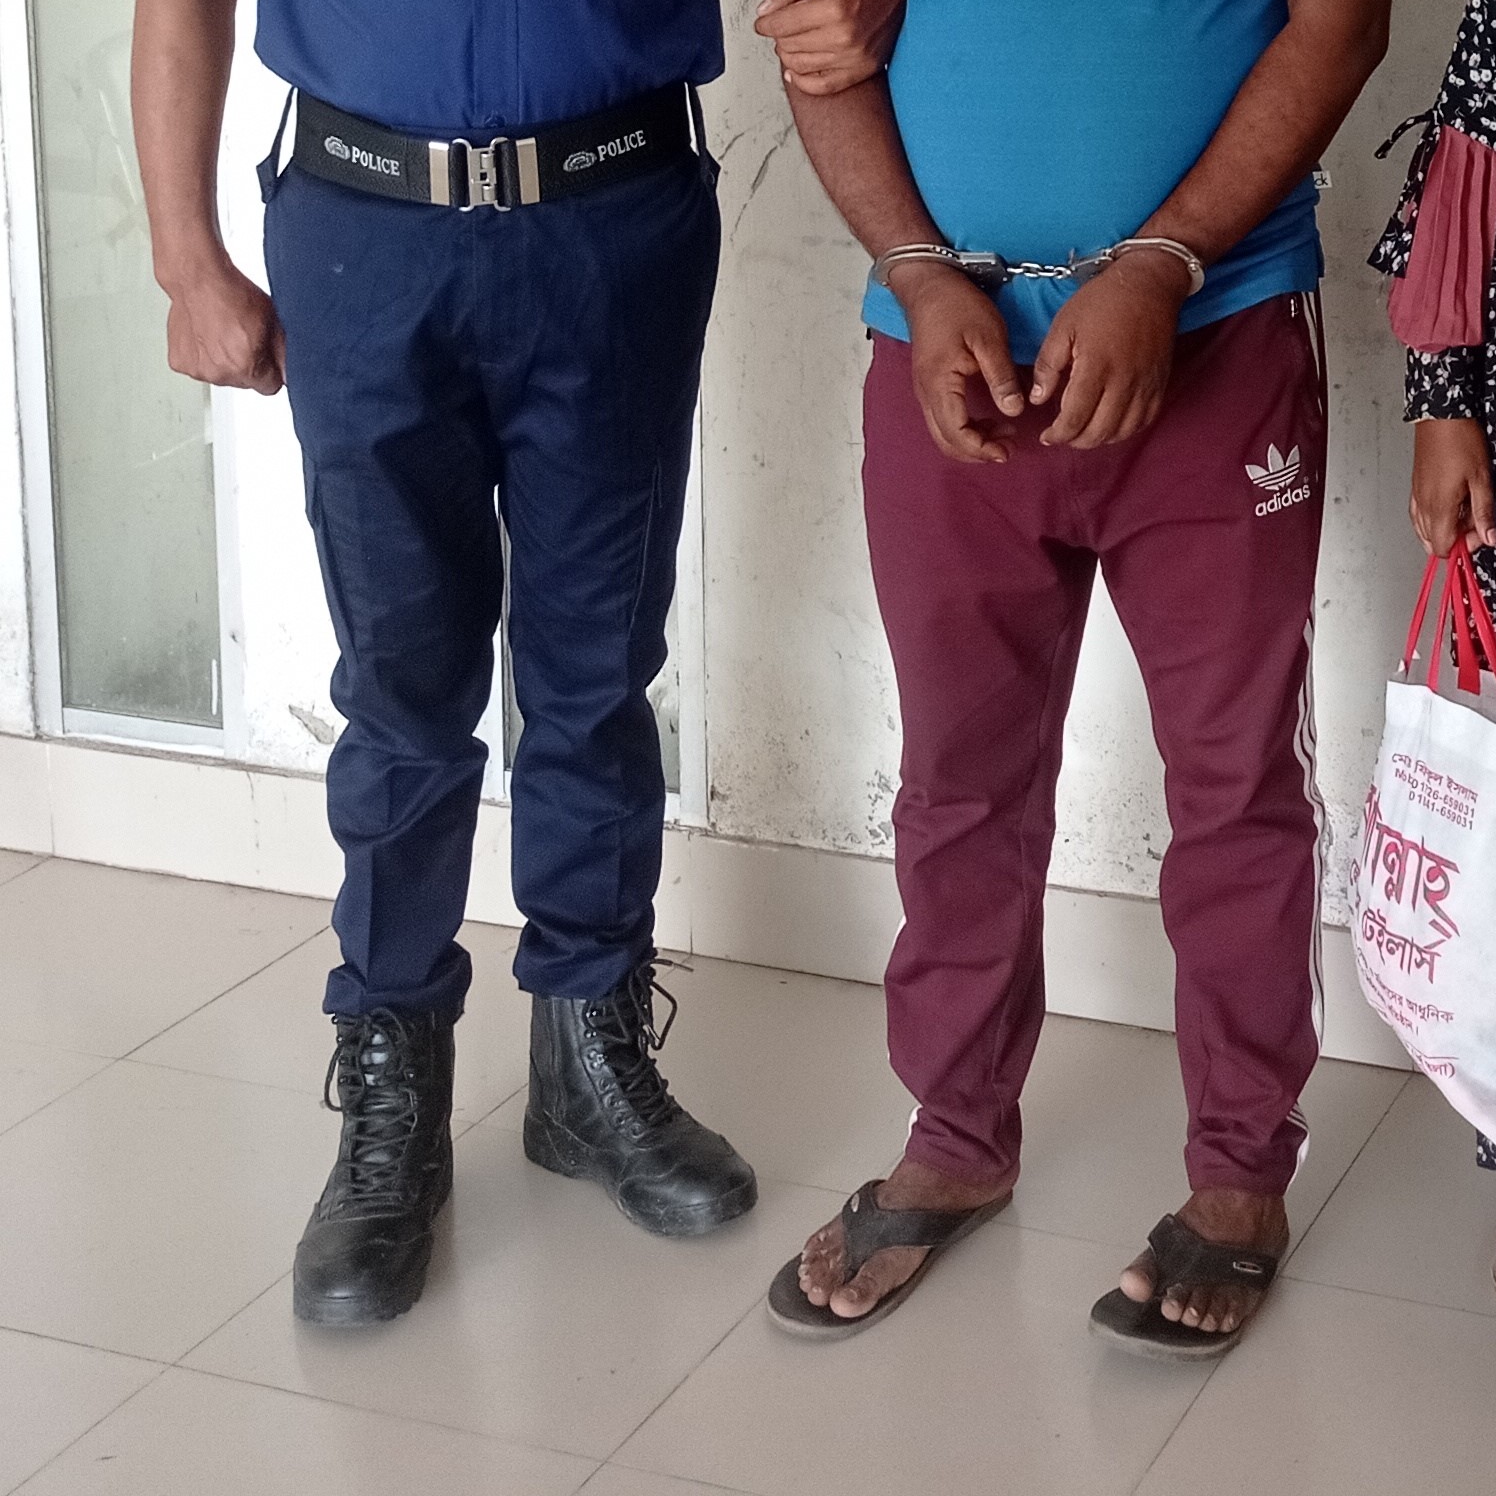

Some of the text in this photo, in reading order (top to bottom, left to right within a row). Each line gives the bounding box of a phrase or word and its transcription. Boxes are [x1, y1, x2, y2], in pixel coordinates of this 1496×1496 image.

[351, 145, 400, 176] POLICE
[597, 129, 646, 162] POLICE
[1314, 173, 1329, 187] ck
[1255, 484, 1311, 517] adidas
